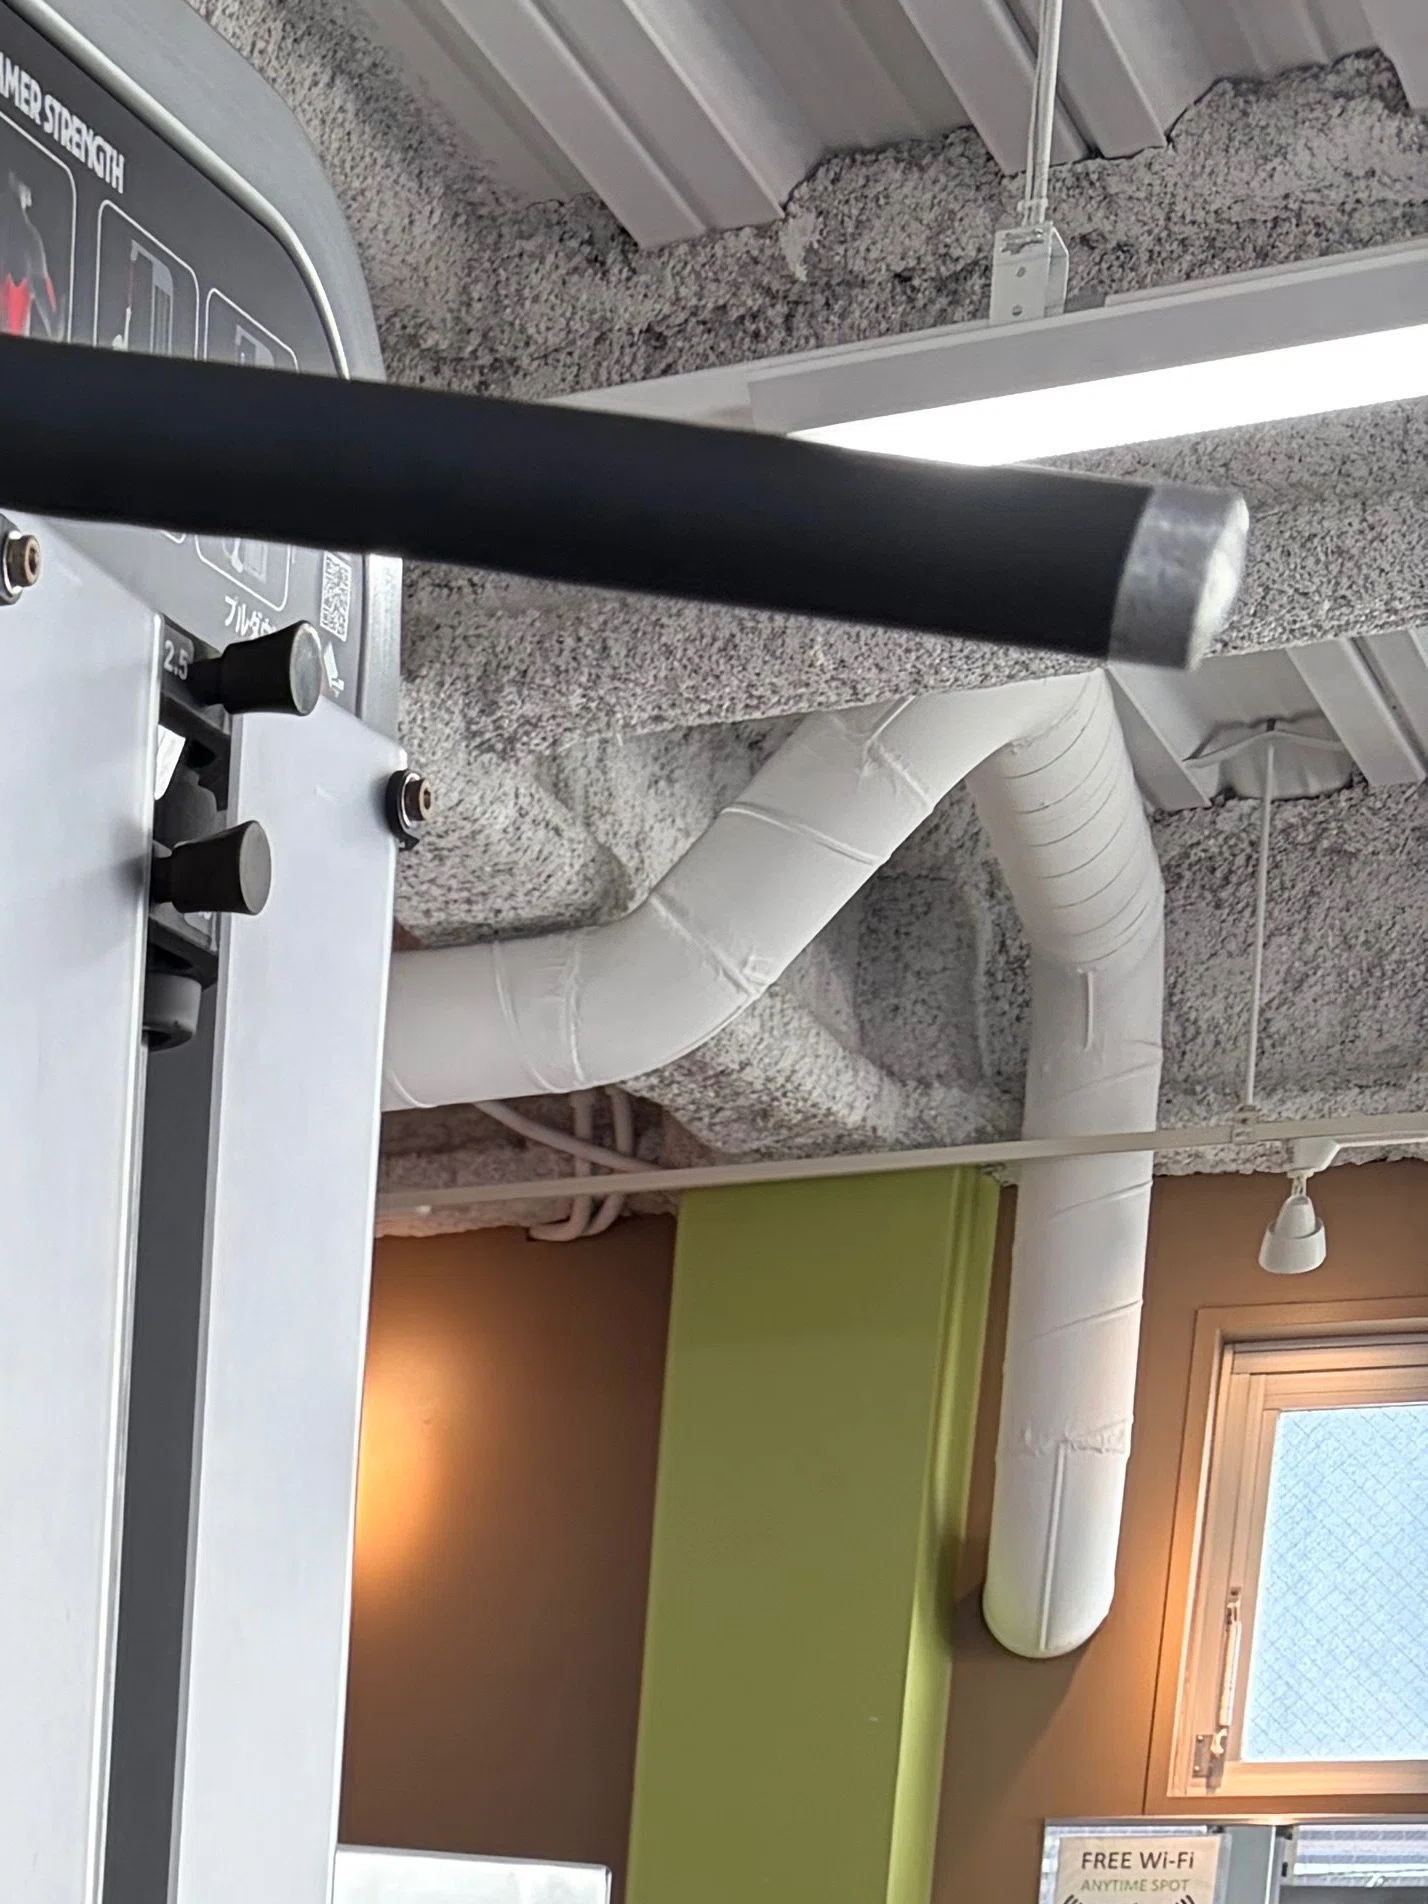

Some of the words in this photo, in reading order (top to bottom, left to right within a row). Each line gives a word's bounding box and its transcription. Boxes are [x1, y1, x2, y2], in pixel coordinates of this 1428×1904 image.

[43, 94, 126, 194] STRENGTH
[164, 640, 189, 680] 2.5
[1081, 1851, 1133, 1870] FREE
[1139, 1851, 1195, 1870] Wi-Fi
[1080, 1879, 1148, 1892] ANYTIME
[1151, 1879, 1190, 1892] SPOT
